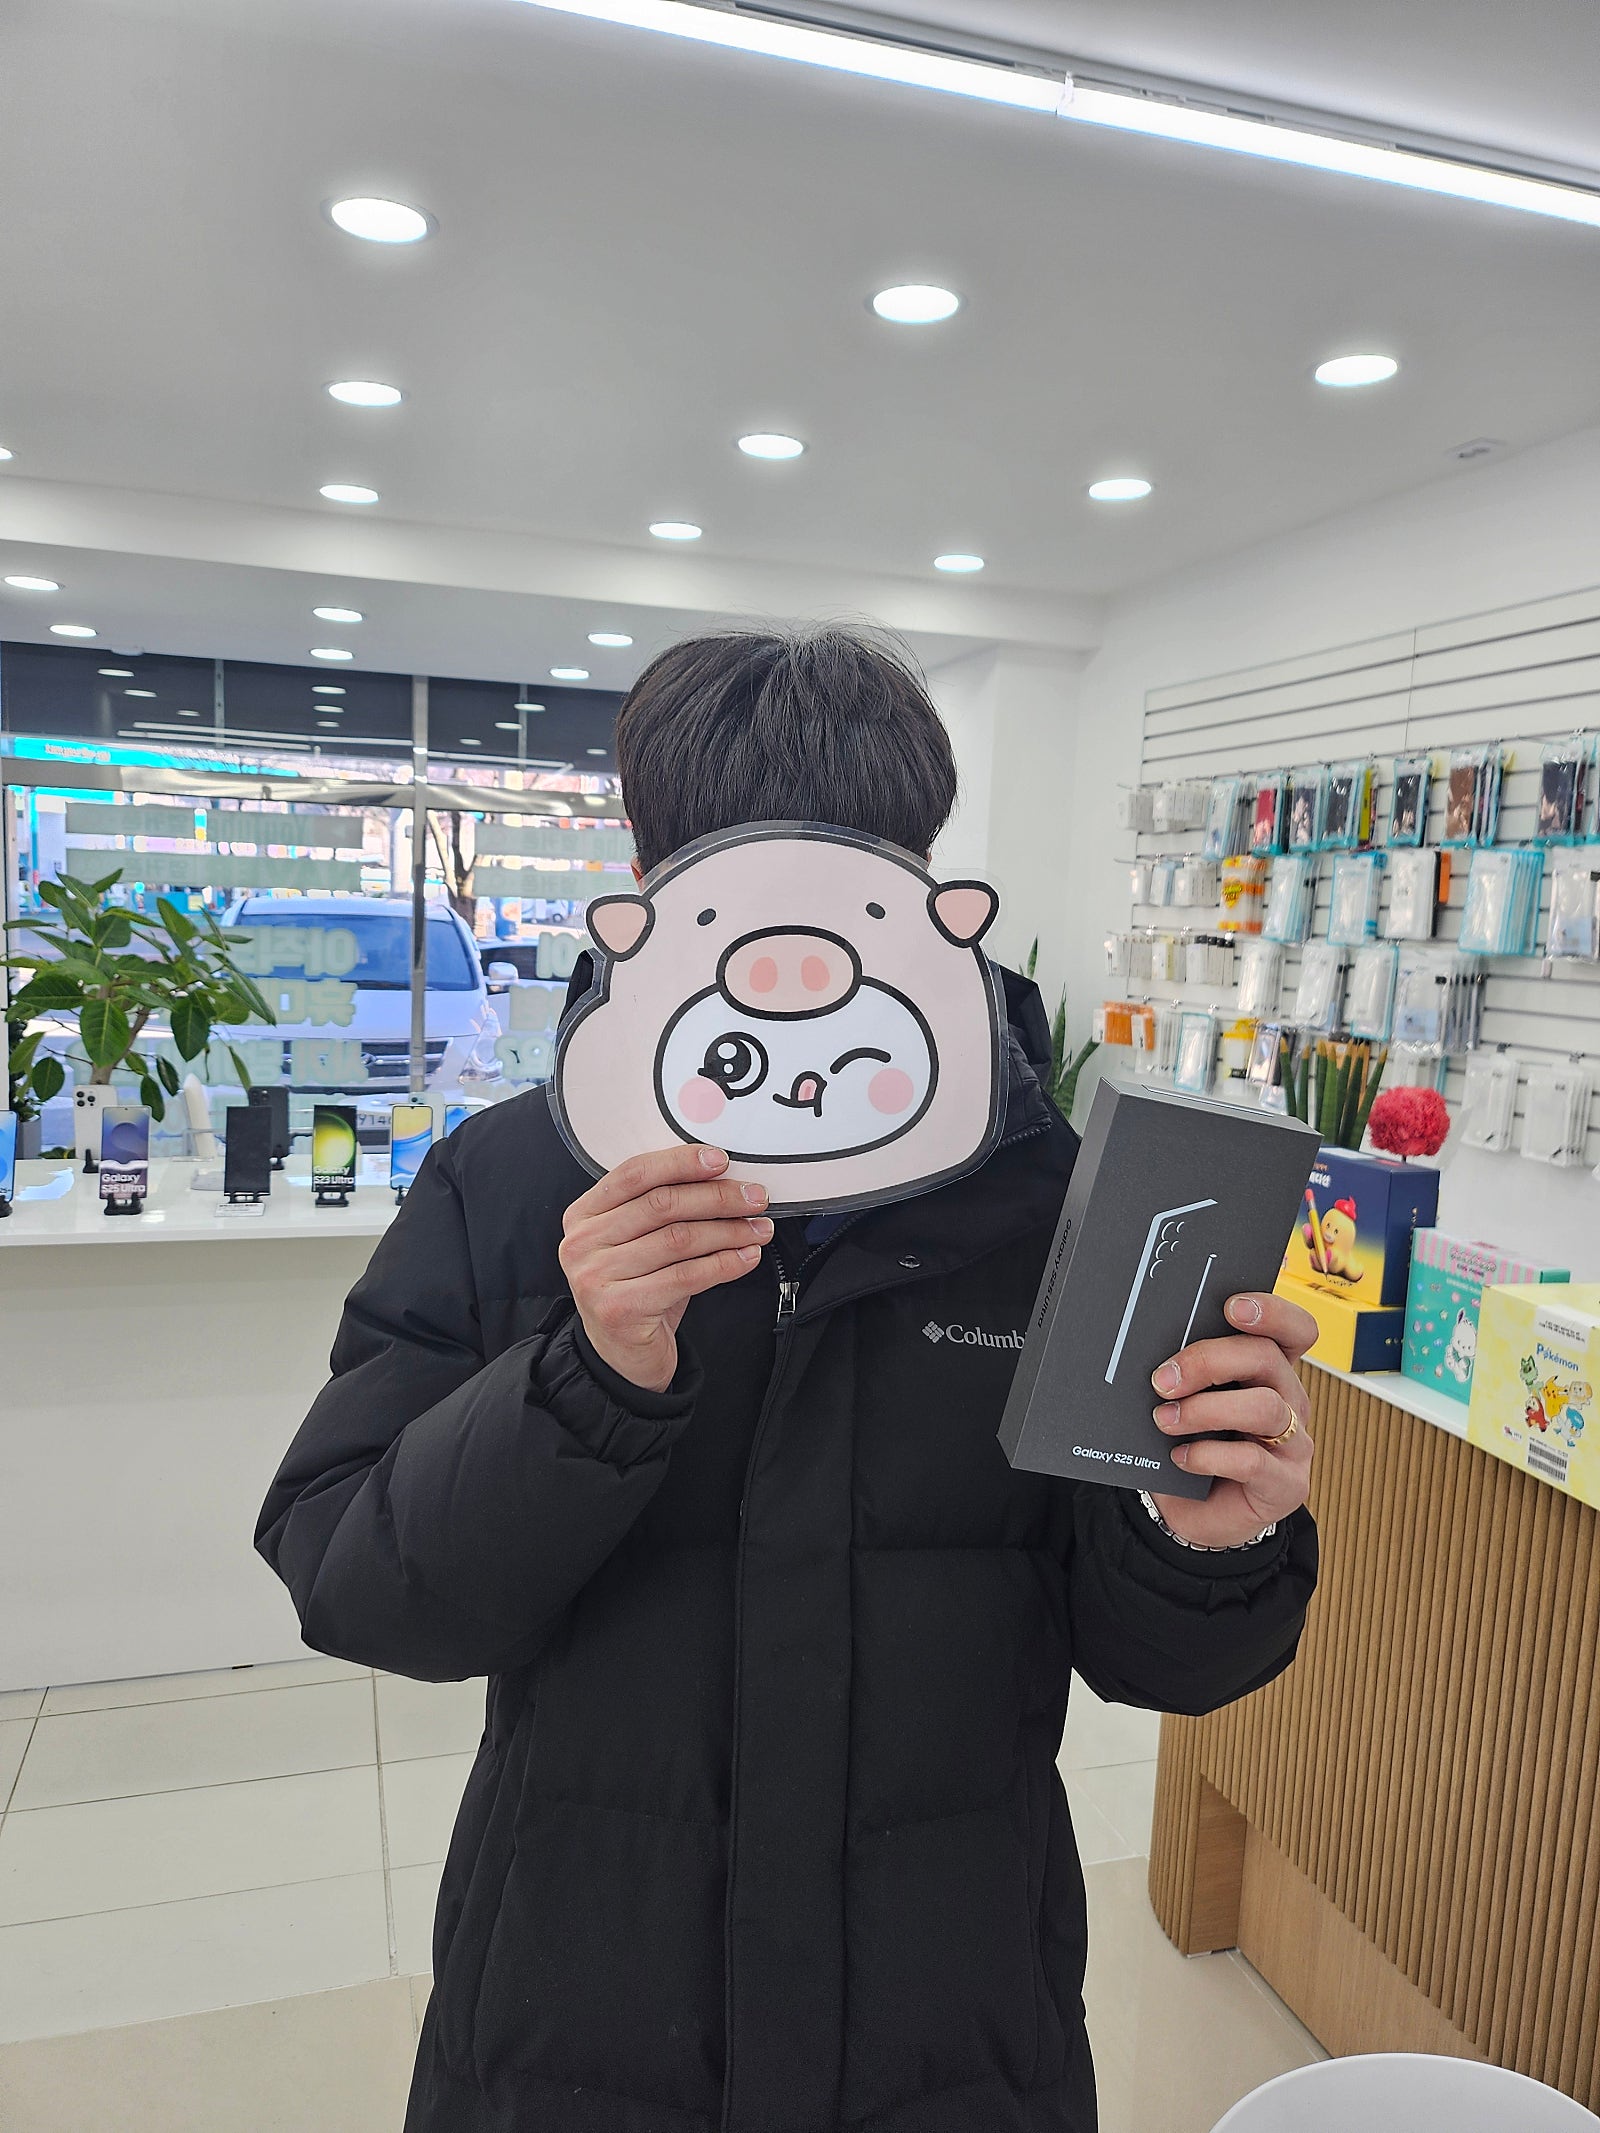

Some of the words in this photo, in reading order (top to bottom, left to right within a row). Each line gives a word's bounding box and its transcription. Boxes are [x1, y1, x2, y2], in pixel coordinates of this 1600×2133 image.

[101, 1184, 120, 1193] S25
[121, 1184, 146, 1193] Ultra
[102, 1173, 140, 1184] Galaxy
[314, 1176, 330, 1184] S23
[331, 1176, 354, 1184] Ultra
[1055, 1218, 1072, 1270] Galaxy
[1047, 1270, 1057, 1295] S25
[1037, 1295, 1050, 1329] Ultra
[945, 1324, 1027, 1349] Columb
[1072, 1445, 1113, 1464] Galaxy
[1113, 1453, 1134, 1466] S25
[1134, 1456, 1161, 1470] Ultra
